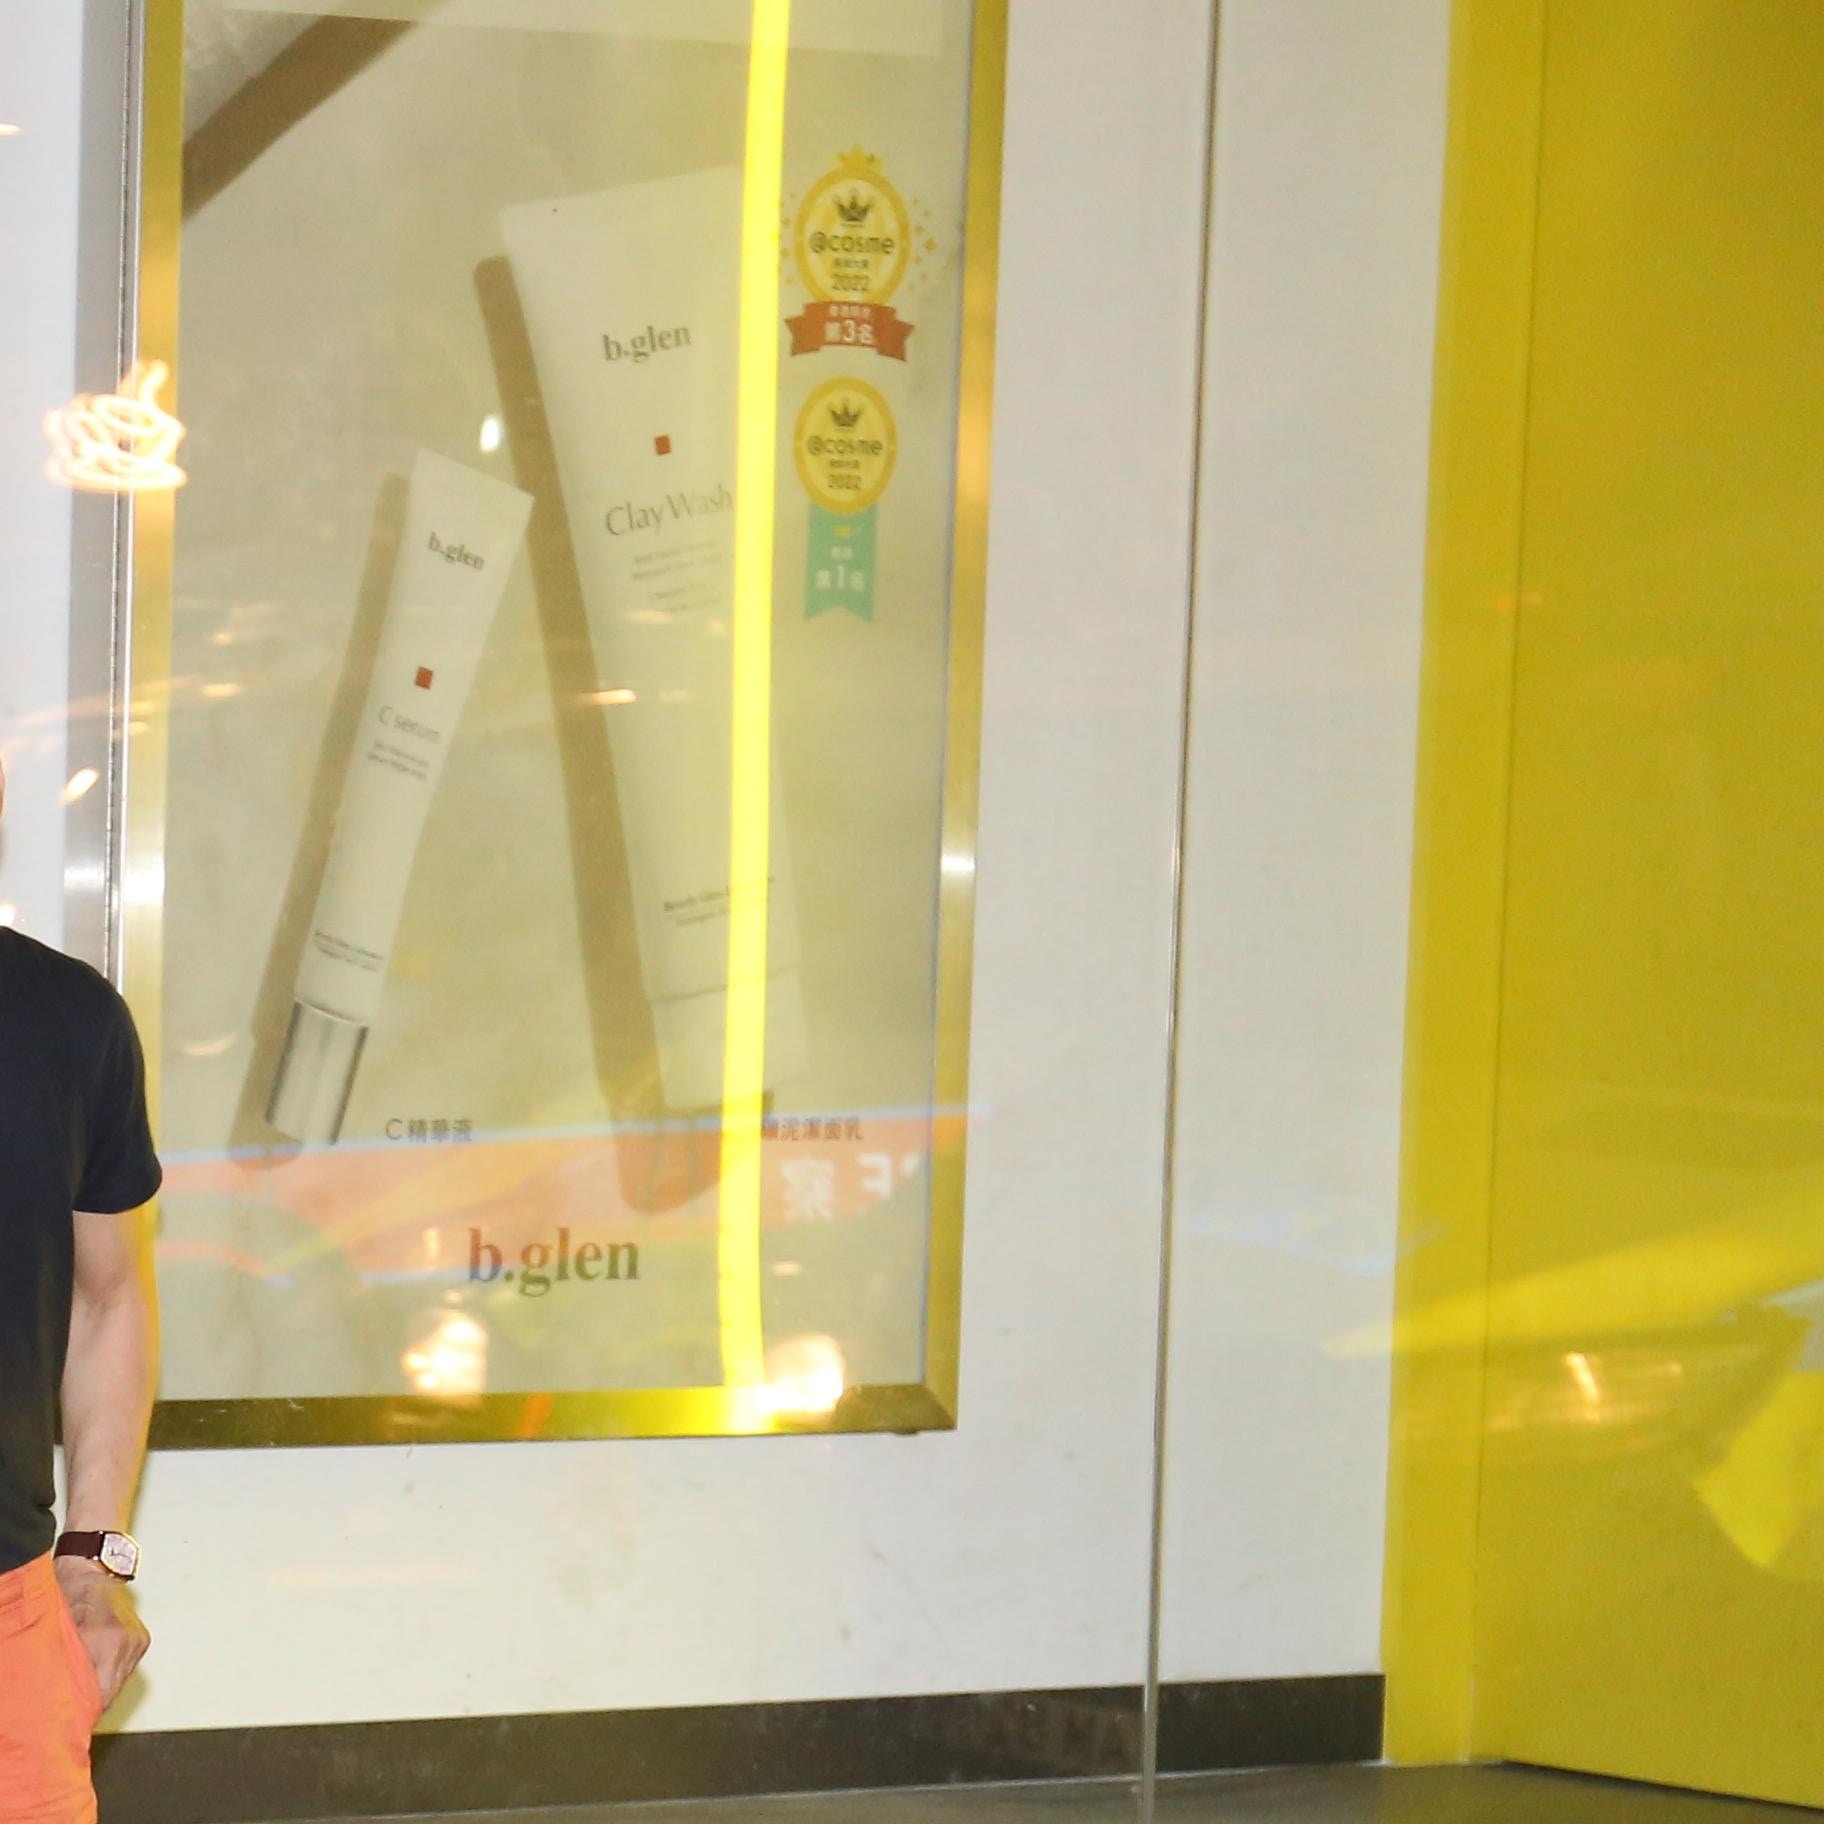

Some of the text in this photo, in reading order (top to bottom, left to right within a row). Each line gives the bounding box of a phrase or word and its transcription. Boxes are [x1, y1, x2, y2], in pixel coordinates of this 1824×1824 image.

[601, 326, 692, 363] b.glen
[605, 500, 665, 535] Clay
[428, 531, 485, 571] b.glen
[467, 1227, 640, 1297] b.glen
